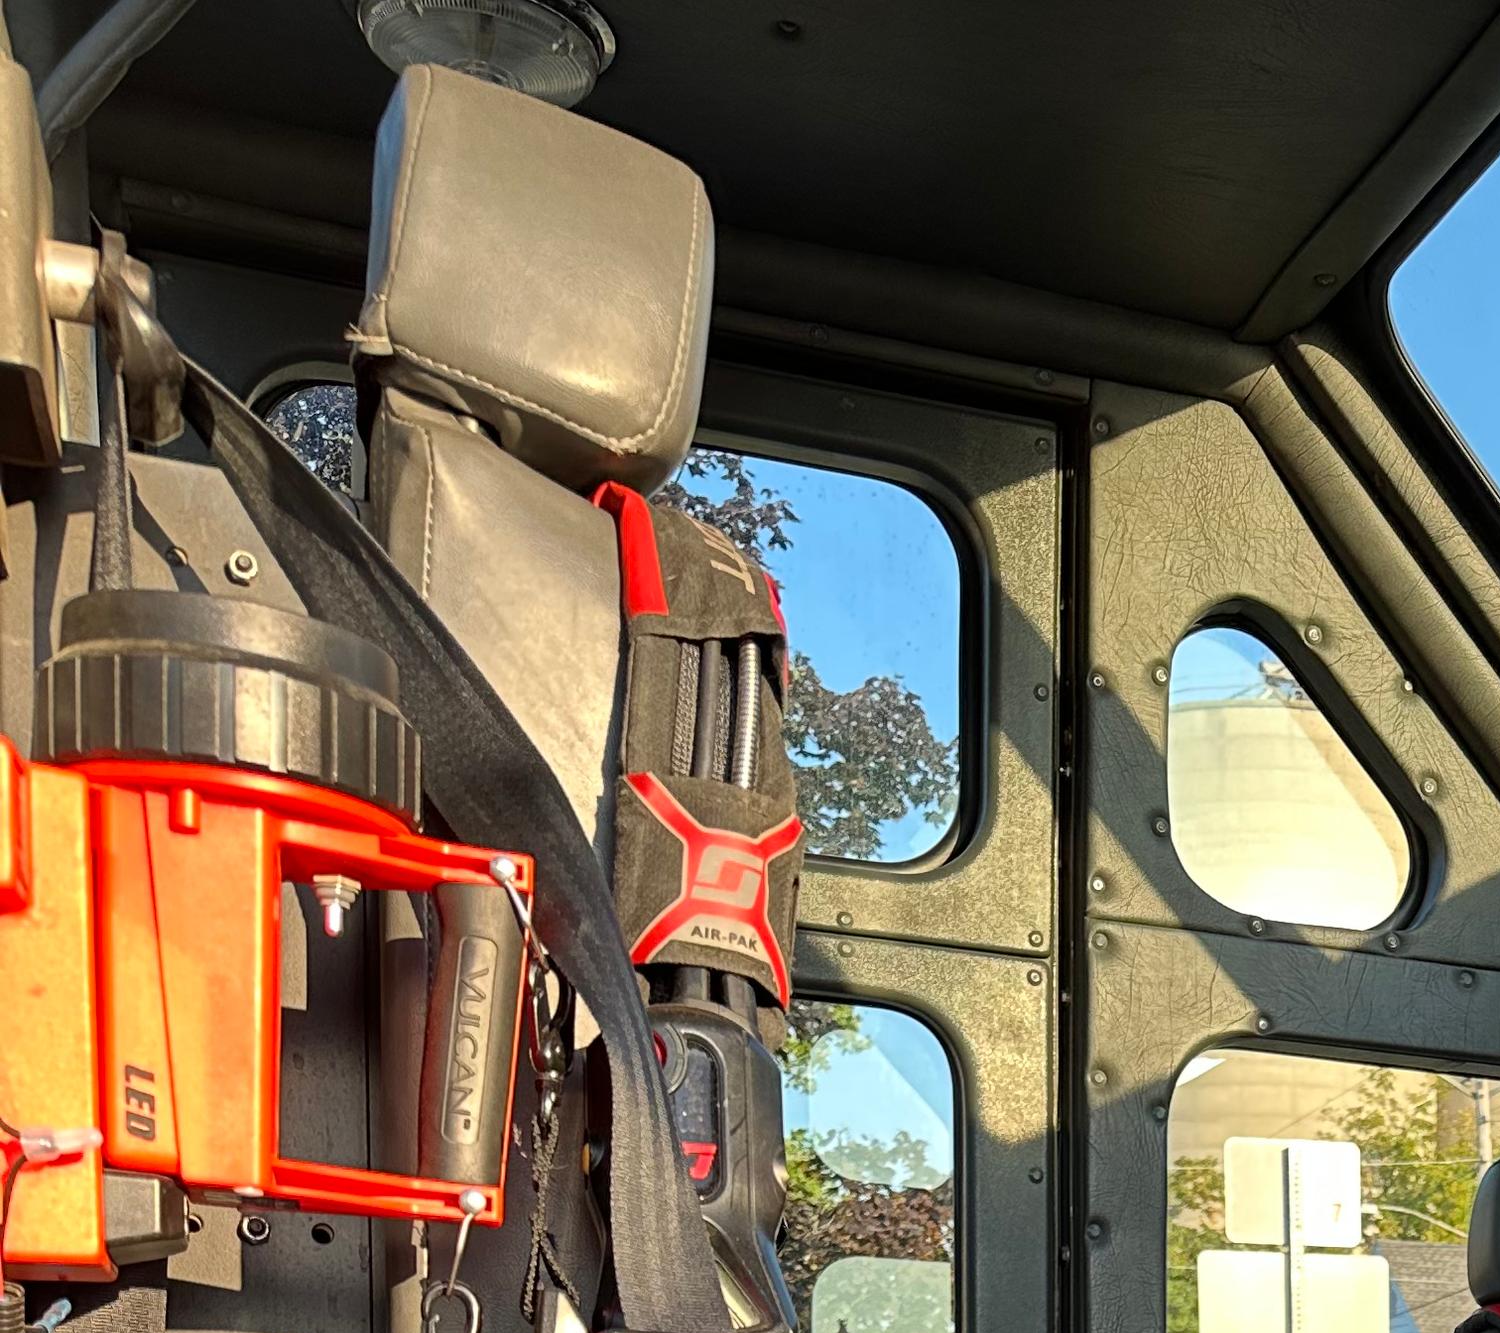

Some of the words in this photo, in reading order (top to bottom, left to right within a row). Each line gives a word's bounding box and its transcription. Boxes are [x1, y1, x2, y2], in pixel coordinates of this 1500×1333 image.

[691, 926, 758, 952] AIR-PAK
[450, 967, 489, 1116] VULCAN
[125, 1064, 155, 1141] LED
